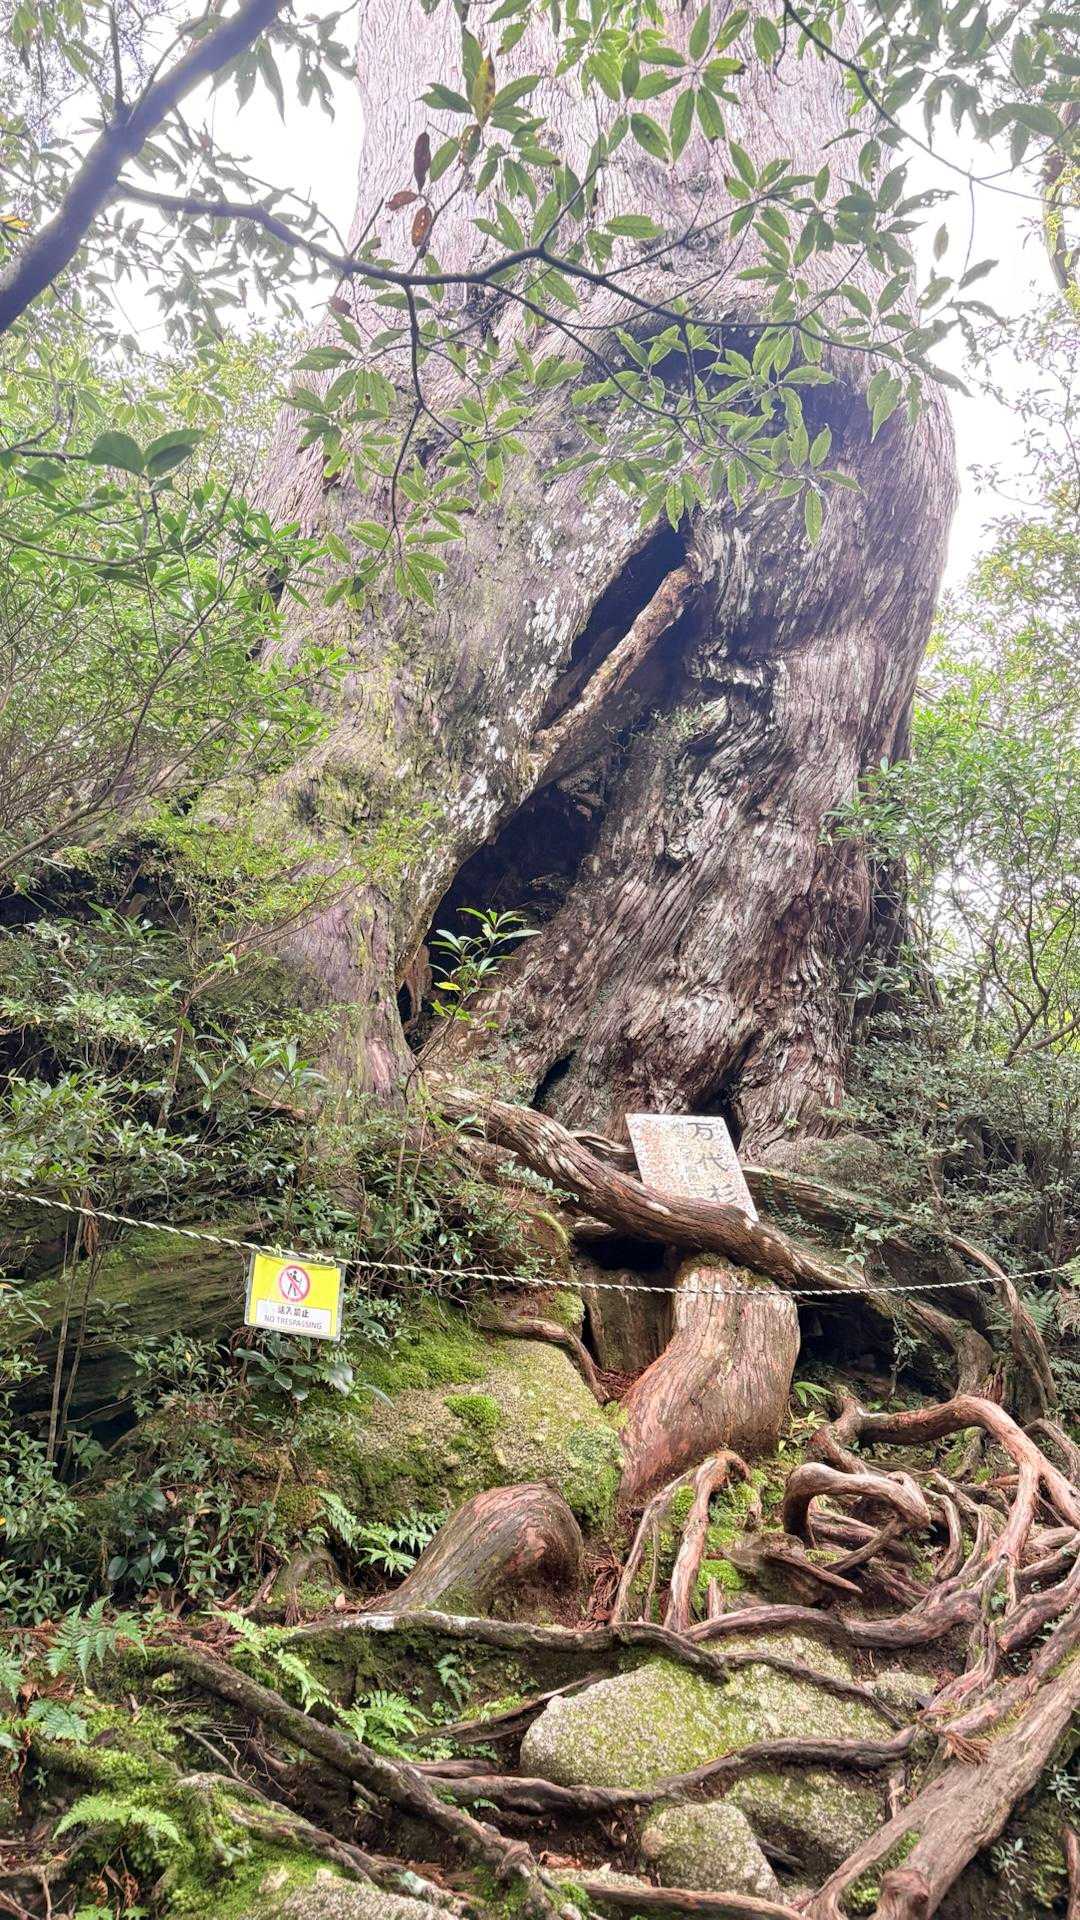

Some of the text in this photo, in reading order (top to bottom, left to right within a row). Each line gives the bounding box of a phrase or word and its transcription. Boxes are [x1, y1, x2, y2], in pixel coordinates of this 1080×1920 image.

[687, 1122, 738, 1203] 万代杉
[264, 1313, 323, 1330] NO TRESPASSING
